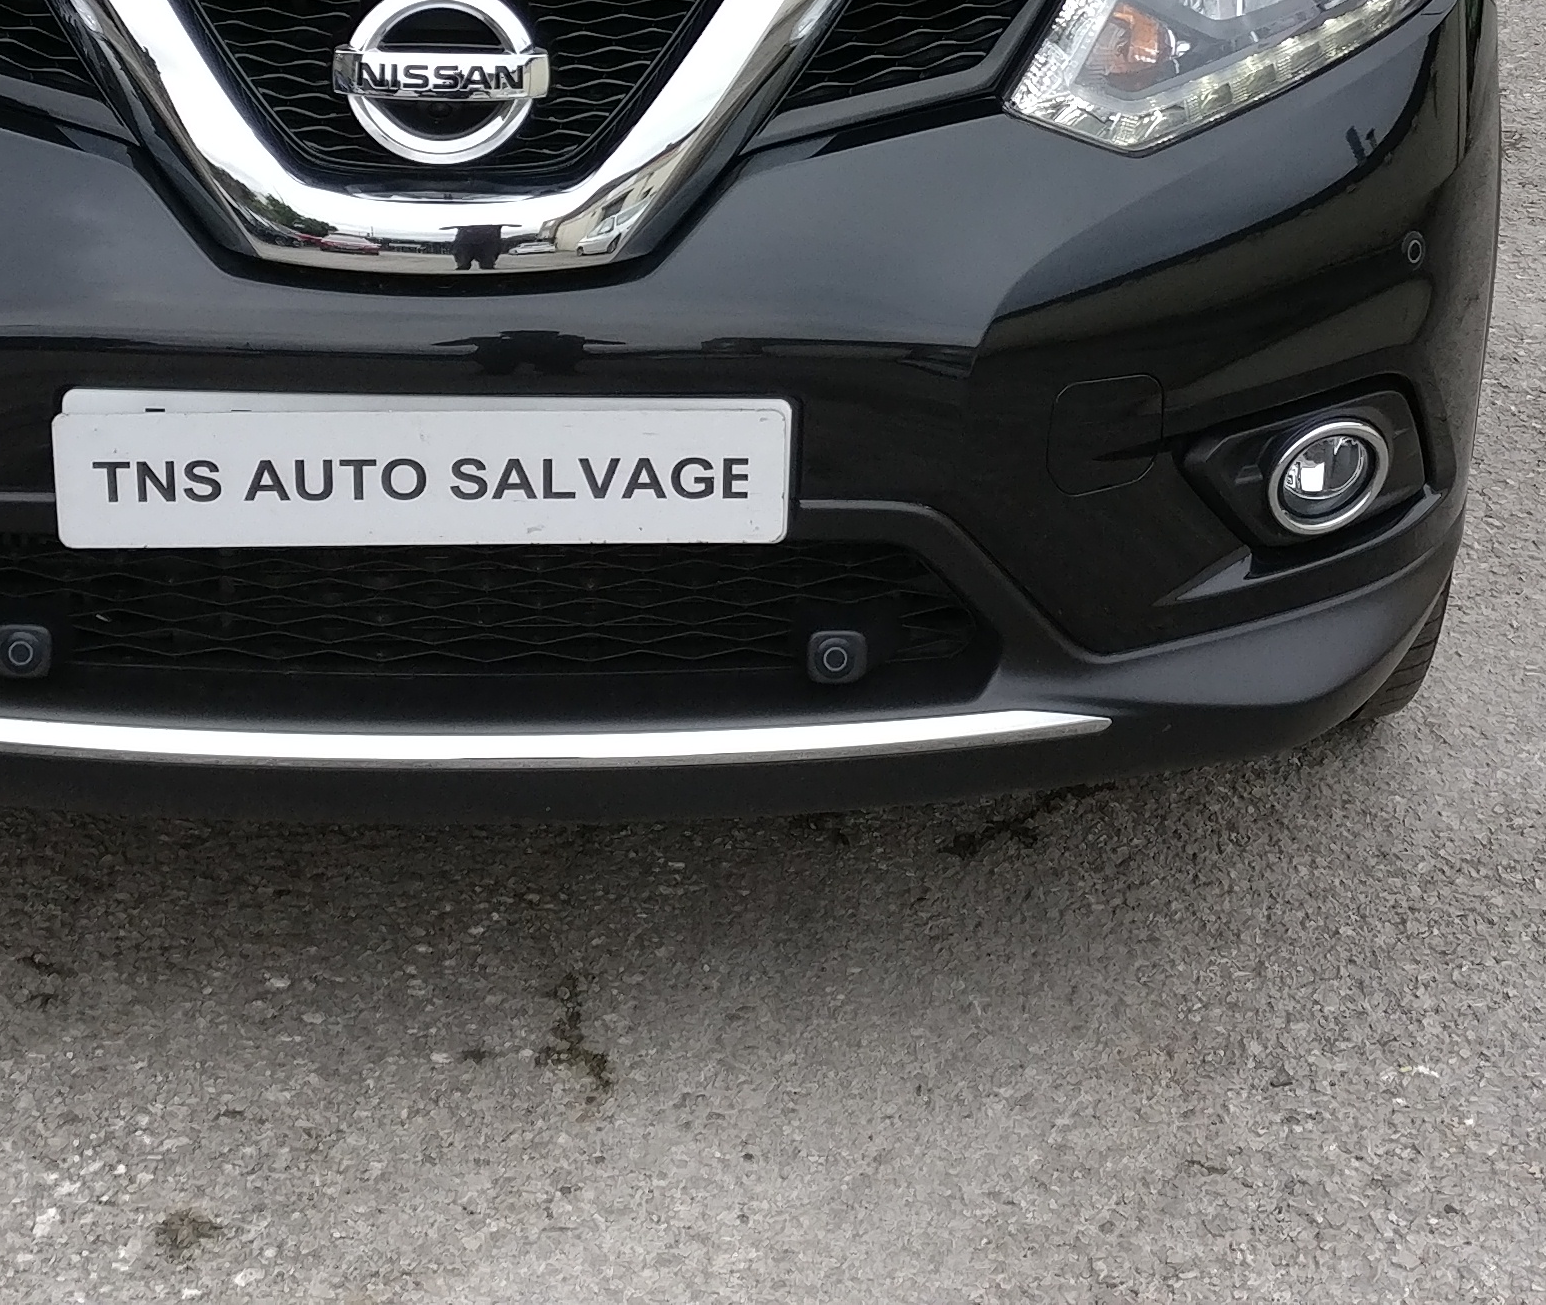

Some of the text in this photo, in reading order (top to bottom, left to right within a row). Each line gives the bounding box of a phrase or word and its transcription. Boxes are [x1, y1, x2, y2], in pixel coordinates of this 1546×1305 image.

[356, 61, 524, 90] NISSAN
[92, 455, 750, 503] TNS AUTO SALVAGE
